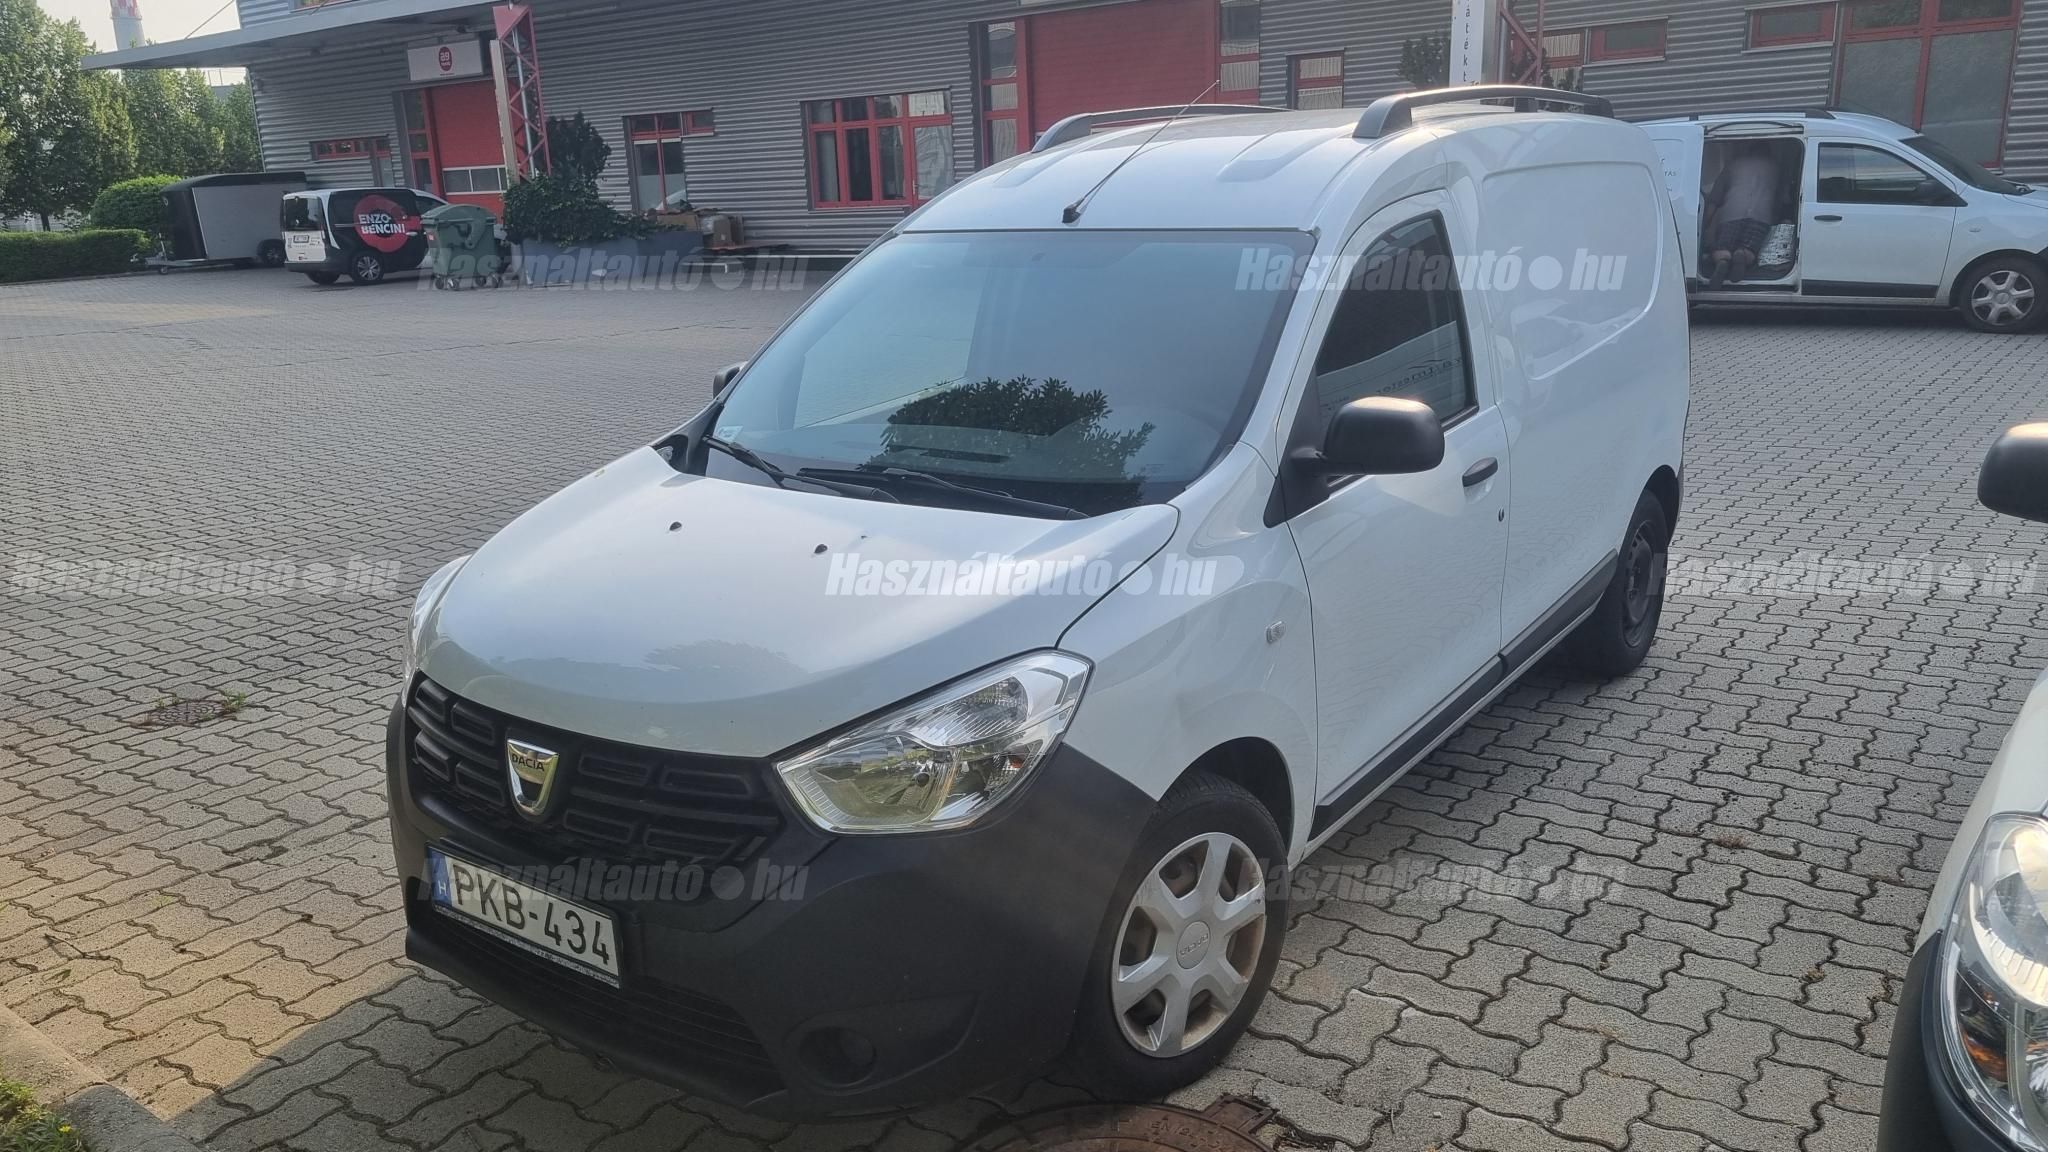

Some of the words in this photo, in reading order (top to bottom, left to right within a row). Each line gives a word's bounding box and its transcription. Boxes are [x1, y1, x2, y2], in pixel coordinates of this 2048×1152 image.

[358, 213, 391, 224] ENZO
[361, 223, 405, 234] BENCINI
[511, 753, 545, 771] DACIA
[438, 881, 447, 896] H
[452, 863, 610, 966] PKB-434
